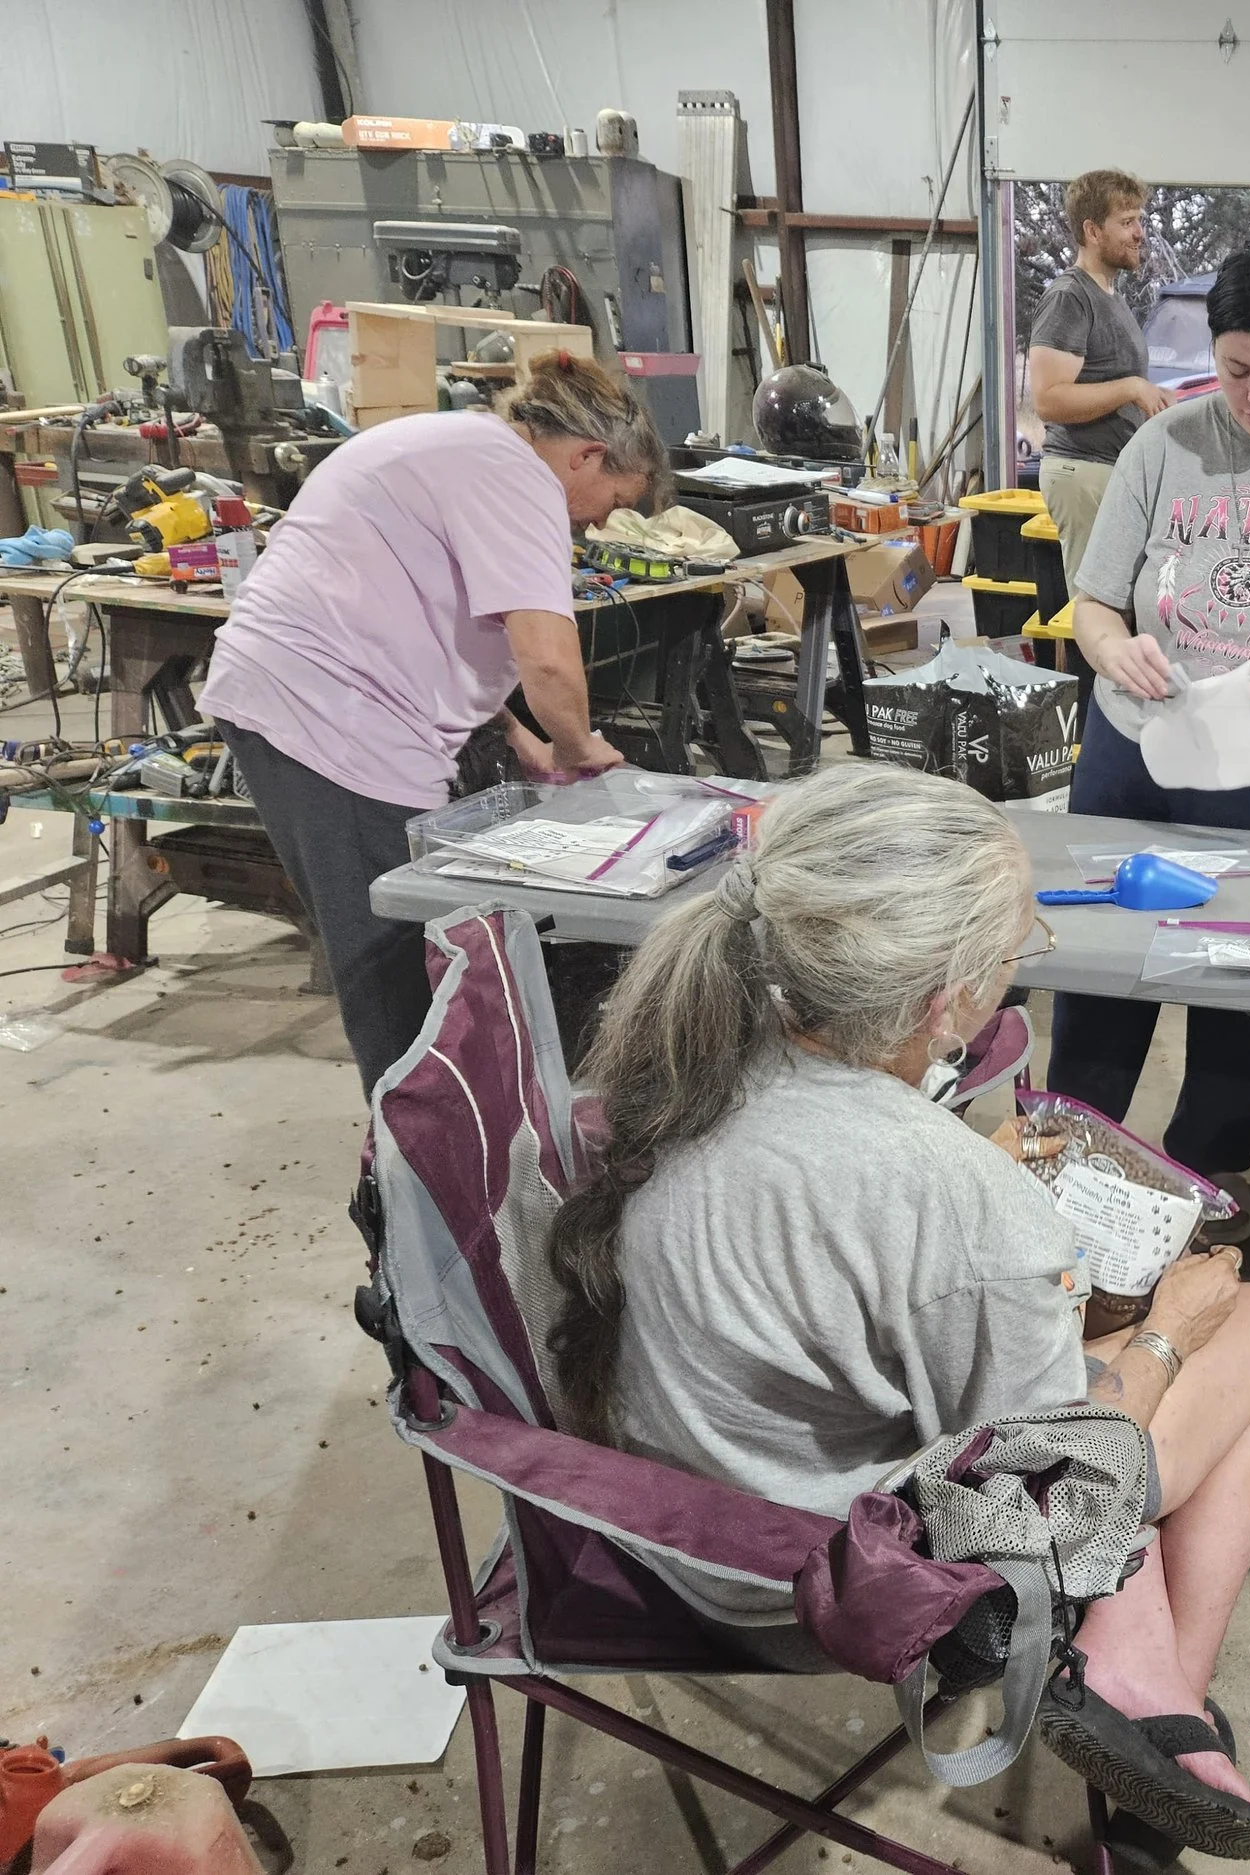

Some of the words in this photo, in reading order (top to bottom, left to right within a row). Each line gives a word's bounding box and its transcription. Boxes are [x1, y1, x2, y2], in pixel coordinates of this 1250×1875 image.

[196, 567, 216, 575] Hefty
[872, 705, 894, 720] PAK
[894, 708, 919, 726] FREE
[957, 711, 967, 738] VALU
[901, 741, 921, 750] GLUTEN
[957, 741, 967, 760] PAK
[967, 734, 989, 763] VP
[1026, 748, 1060, 772] VALU
[1041, 765, 1072, 781] performanc
